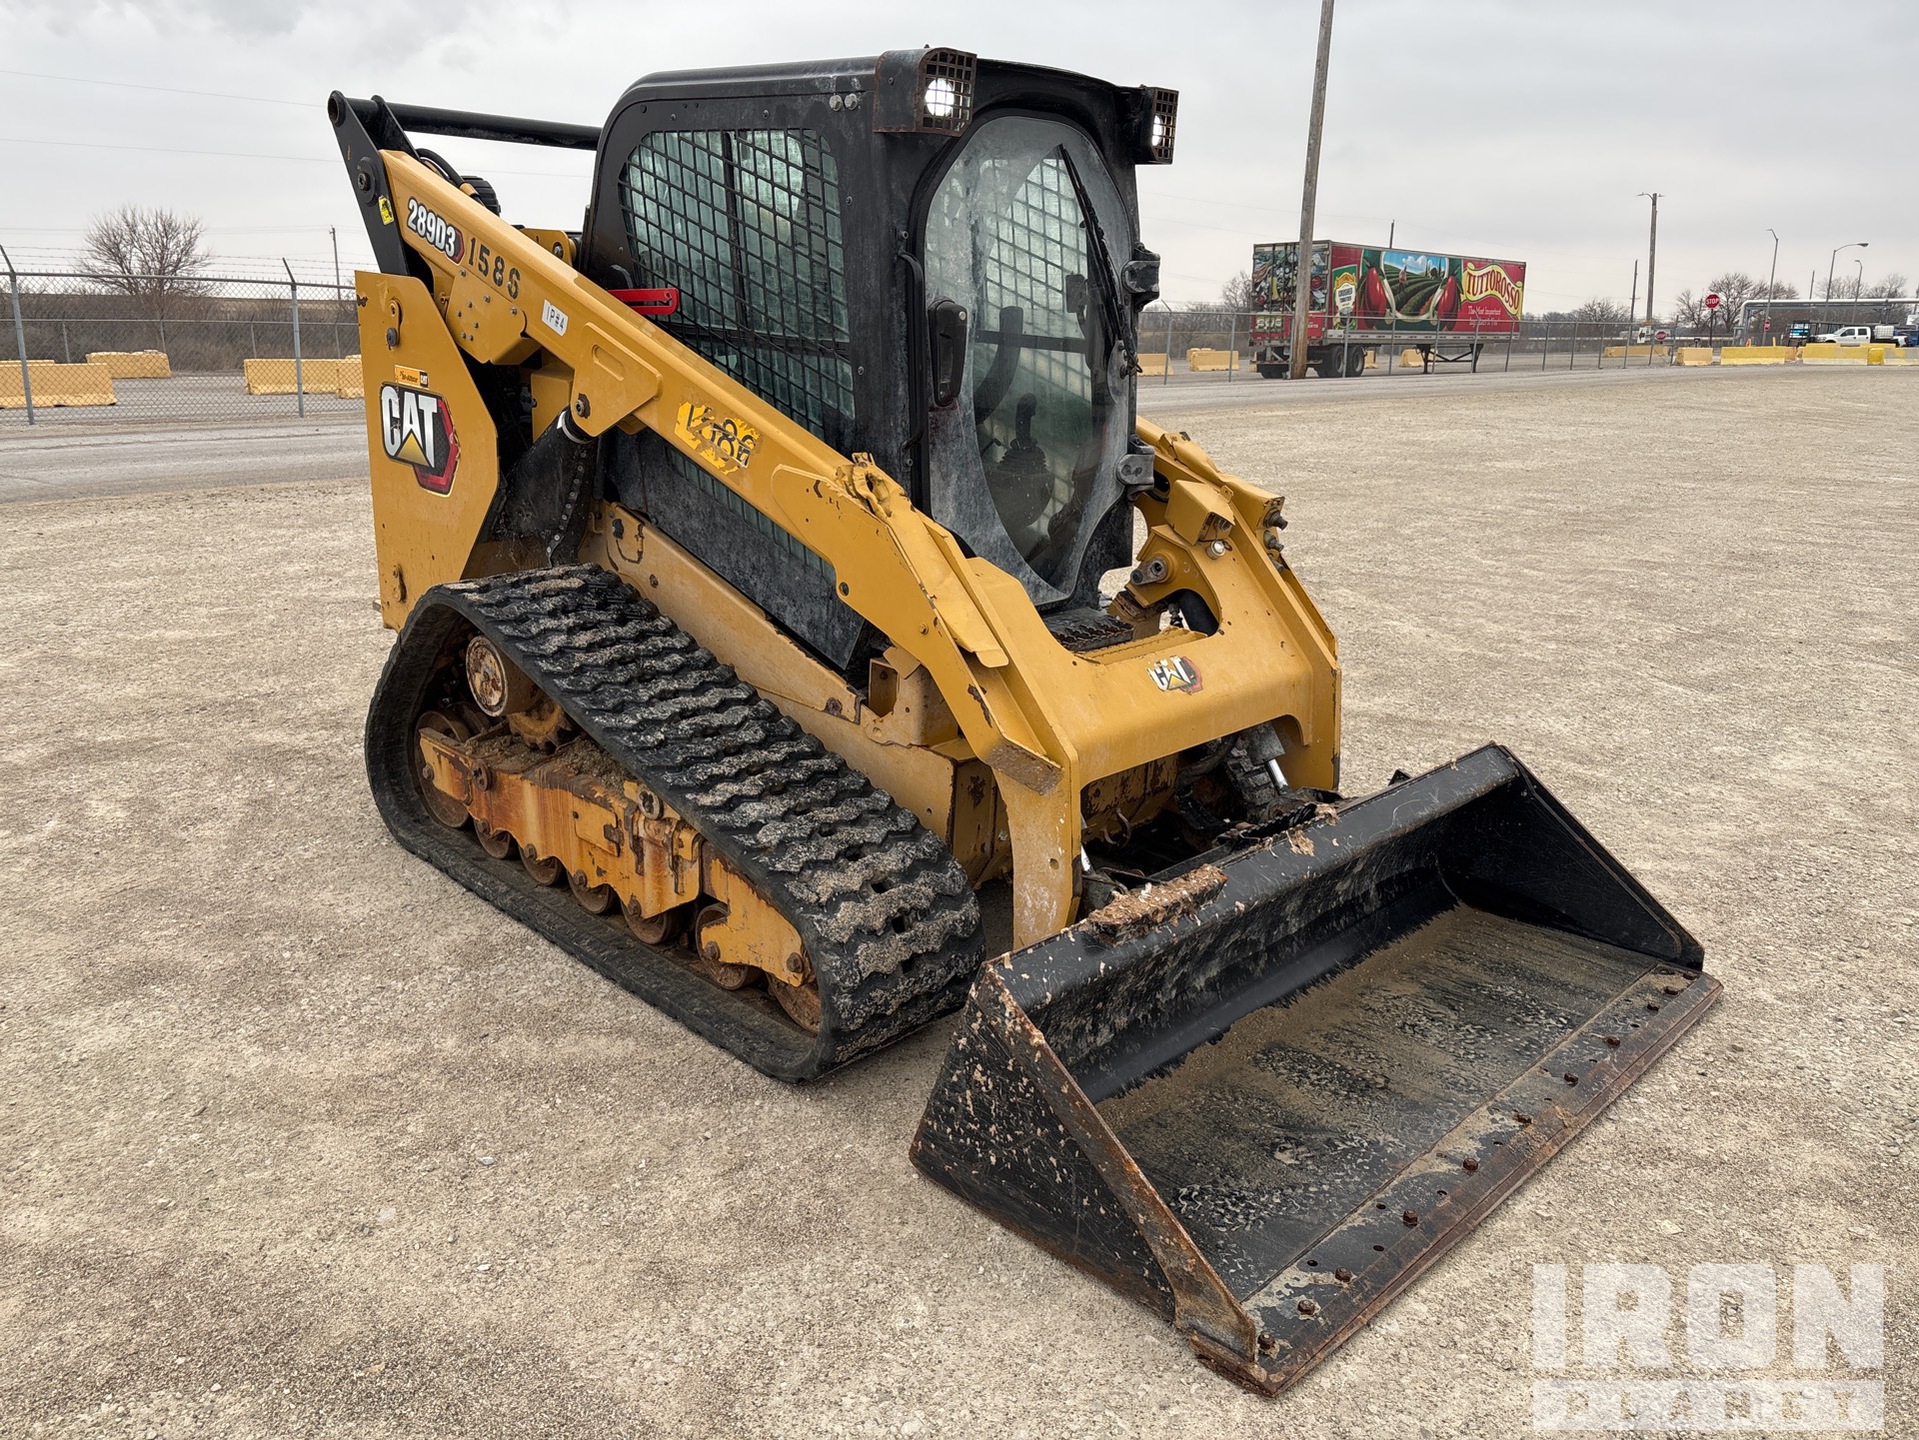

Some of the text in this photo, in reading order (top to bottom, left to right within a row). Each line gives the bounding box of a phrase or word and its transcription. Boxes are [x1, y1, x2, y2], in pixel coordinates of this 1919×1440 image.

[407, 198, 456, 258] 289D3
[468, 237, 520, 300] 1586
[1467, 269, 1520, 310] TUTTOROSSO
[381, 386, 438, 468] CAT
